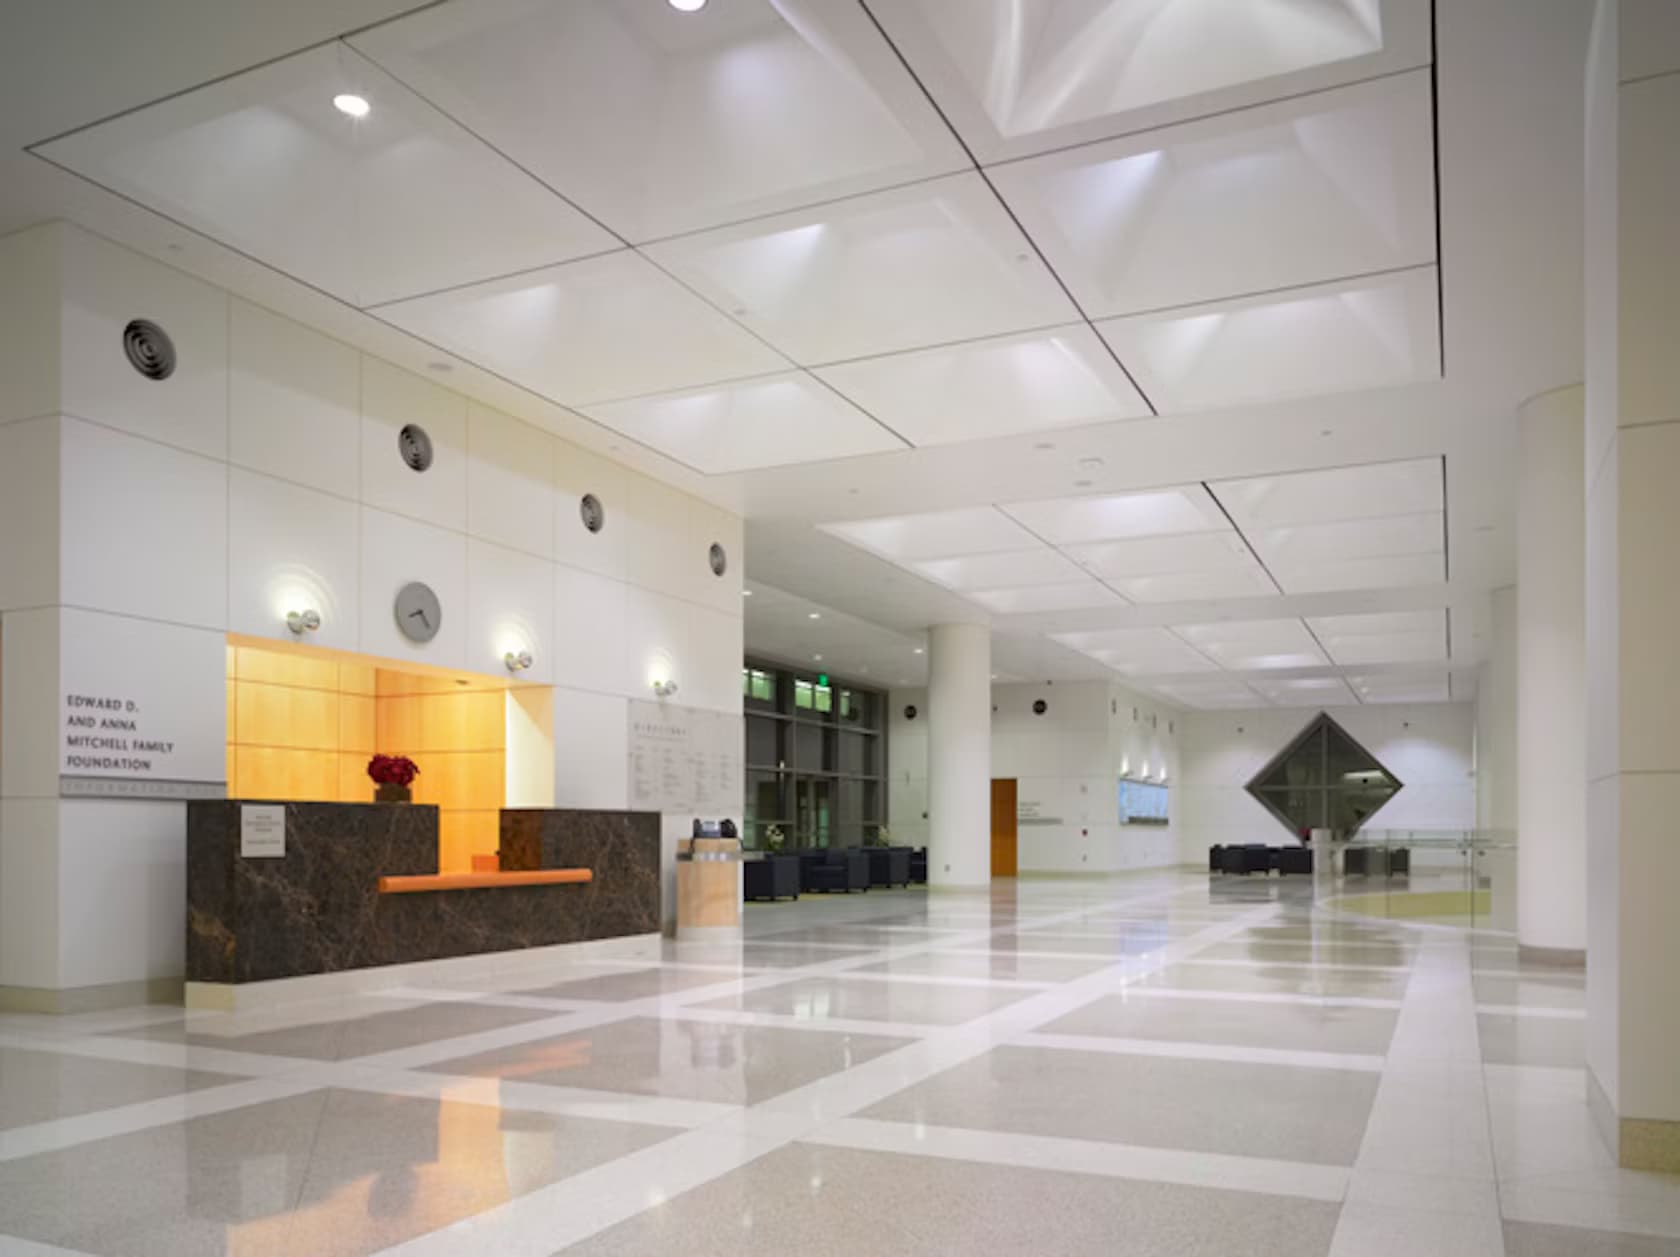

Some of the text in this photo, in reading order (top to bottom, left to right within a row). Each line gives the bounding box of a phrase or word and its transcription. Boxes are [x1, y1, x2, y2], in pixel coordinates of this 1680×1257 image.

[67, 694, 140, 713] EDWARD D.
[67, 715, 137, 732] AND ANNA
[67, 735, 174, 753] MITCHELL FAMILY
[67, 755, 152, 771] FOUNDATION
